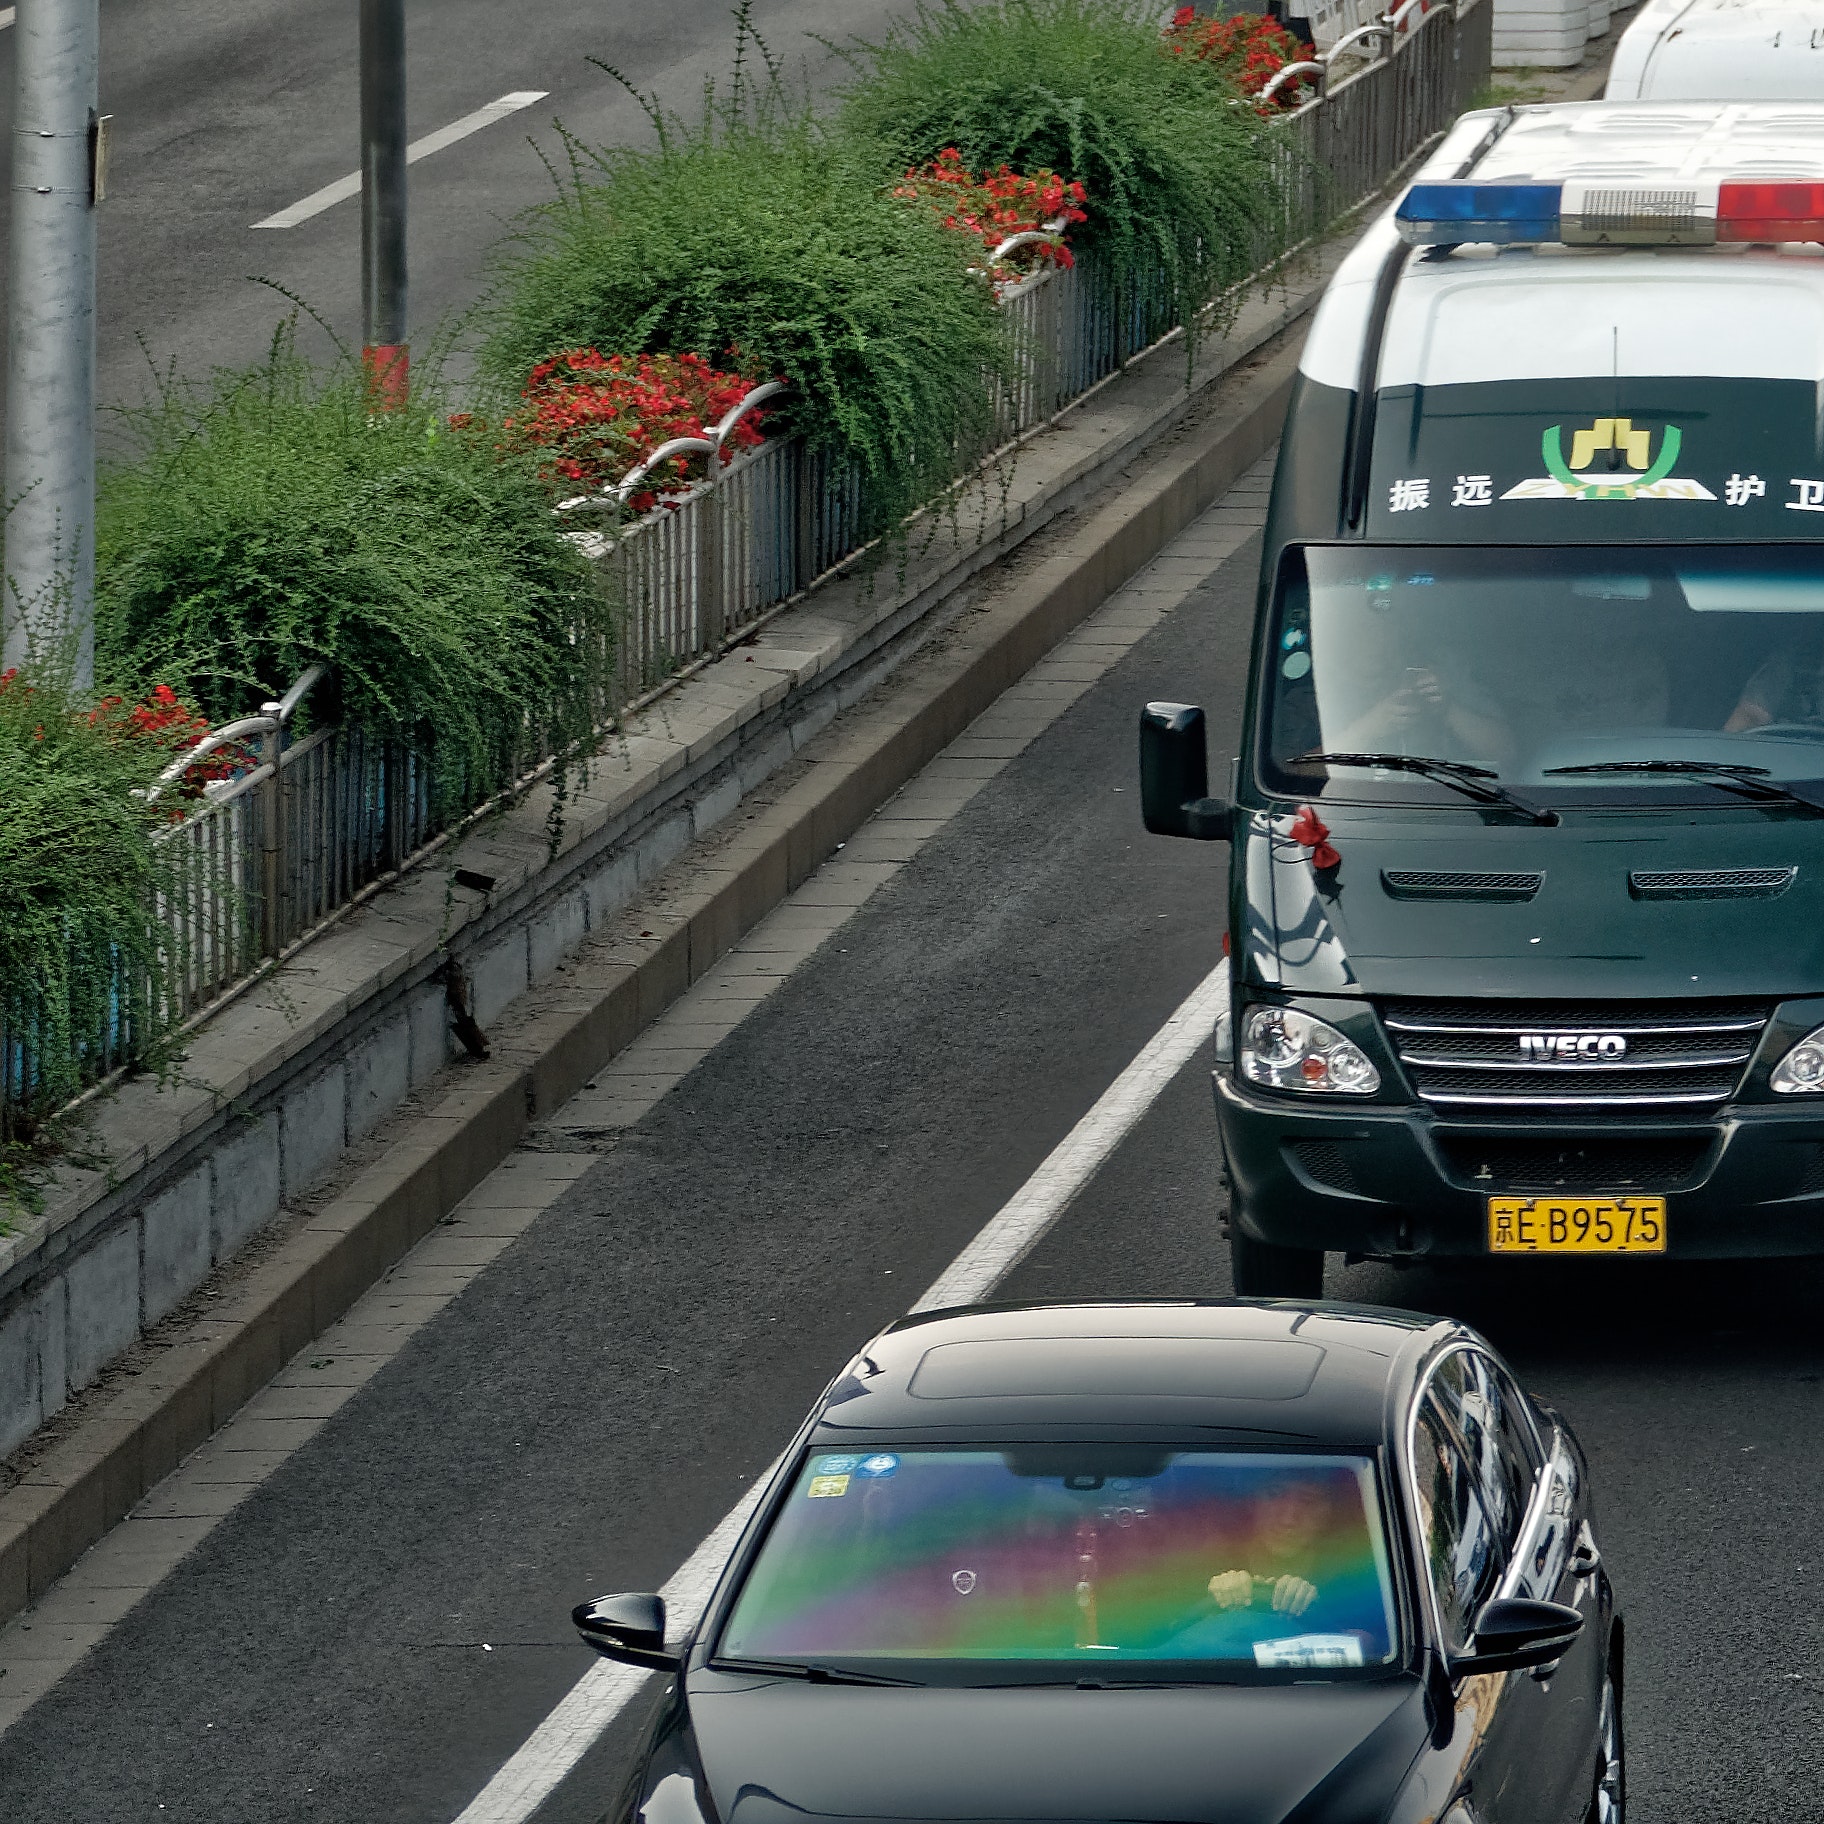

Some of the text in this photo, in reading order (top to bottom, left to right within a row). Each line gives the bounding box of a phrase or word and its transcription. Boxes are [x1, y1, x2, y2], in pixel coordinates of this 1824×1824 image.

[1388, 474, 1494, 513] 振远
[1519, 1035, 1627, 1061] IVECO
[1495, 1207, 1660, 1244] 京E·B9575
